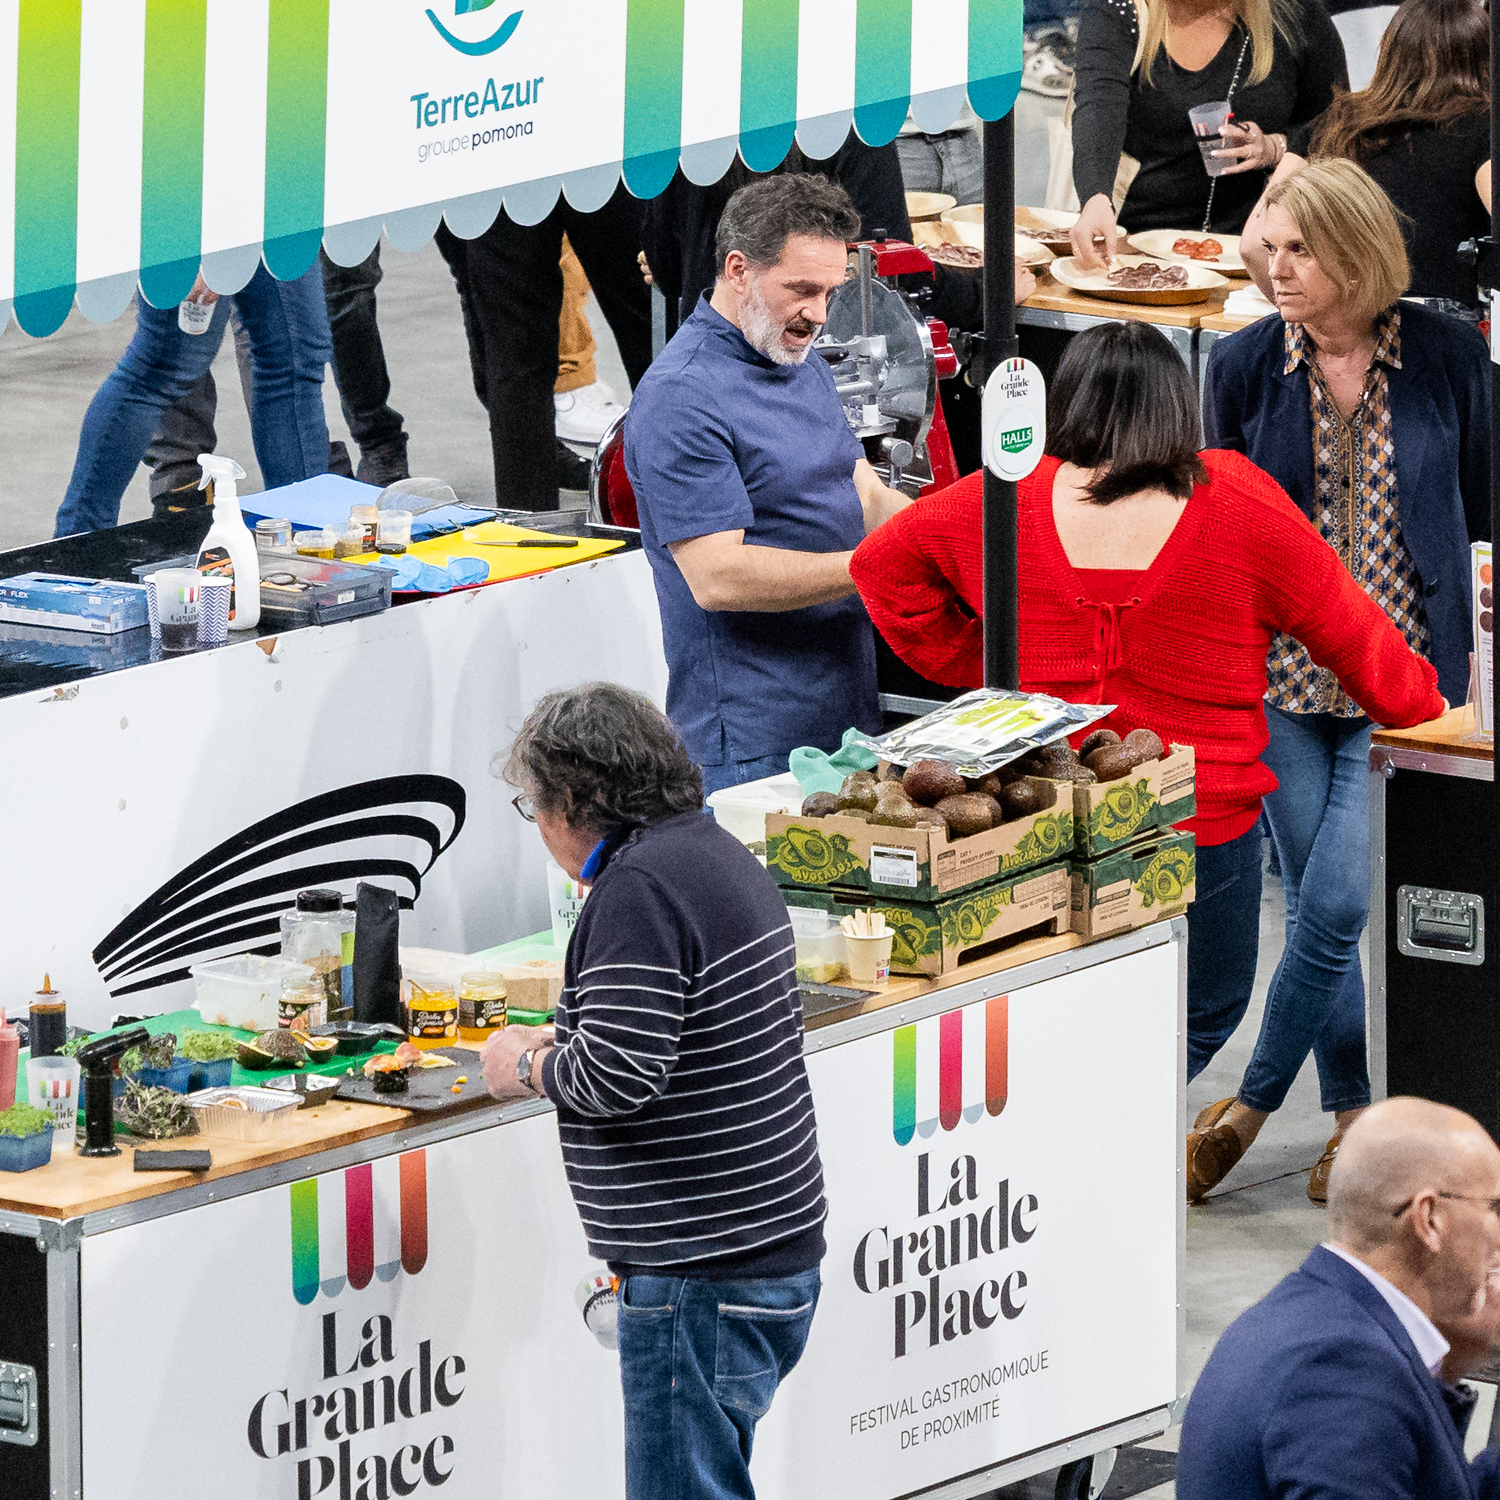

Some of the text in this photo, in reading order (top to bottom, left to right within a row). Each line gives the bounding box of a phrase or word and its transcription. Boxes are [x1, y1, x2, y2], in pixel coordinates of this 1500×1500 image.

[410, 77, 544, 129] TerreAzur
[418, 121, 533, 163] groupe pomona
[1000, 378, 1030, 391] Grande
[1006, 387, 1029, 399] Place
[1010, 373, 1021, 382] La
[1002, 429, 1032, 447] HALLS
[793, 857, 852, 882] AVOCADOS
[1002, 845, 1043, 870] AVOCADOS
[912, 1150, 979, 1219] La
[852, 1178, 1039, 1295] Grande
[890, 1269, 1027, 1362] Place
[317, 1310, 397, 1382] La
[247, 1339, 467, 1460] Grande
[849, 1349, 1049, 1435] FESTIVAL GASTRONOMIQUE
[900, 1391, 1000, 1450] DE PROXIMITÉ
[295, 1434, 455, 1500] Place
